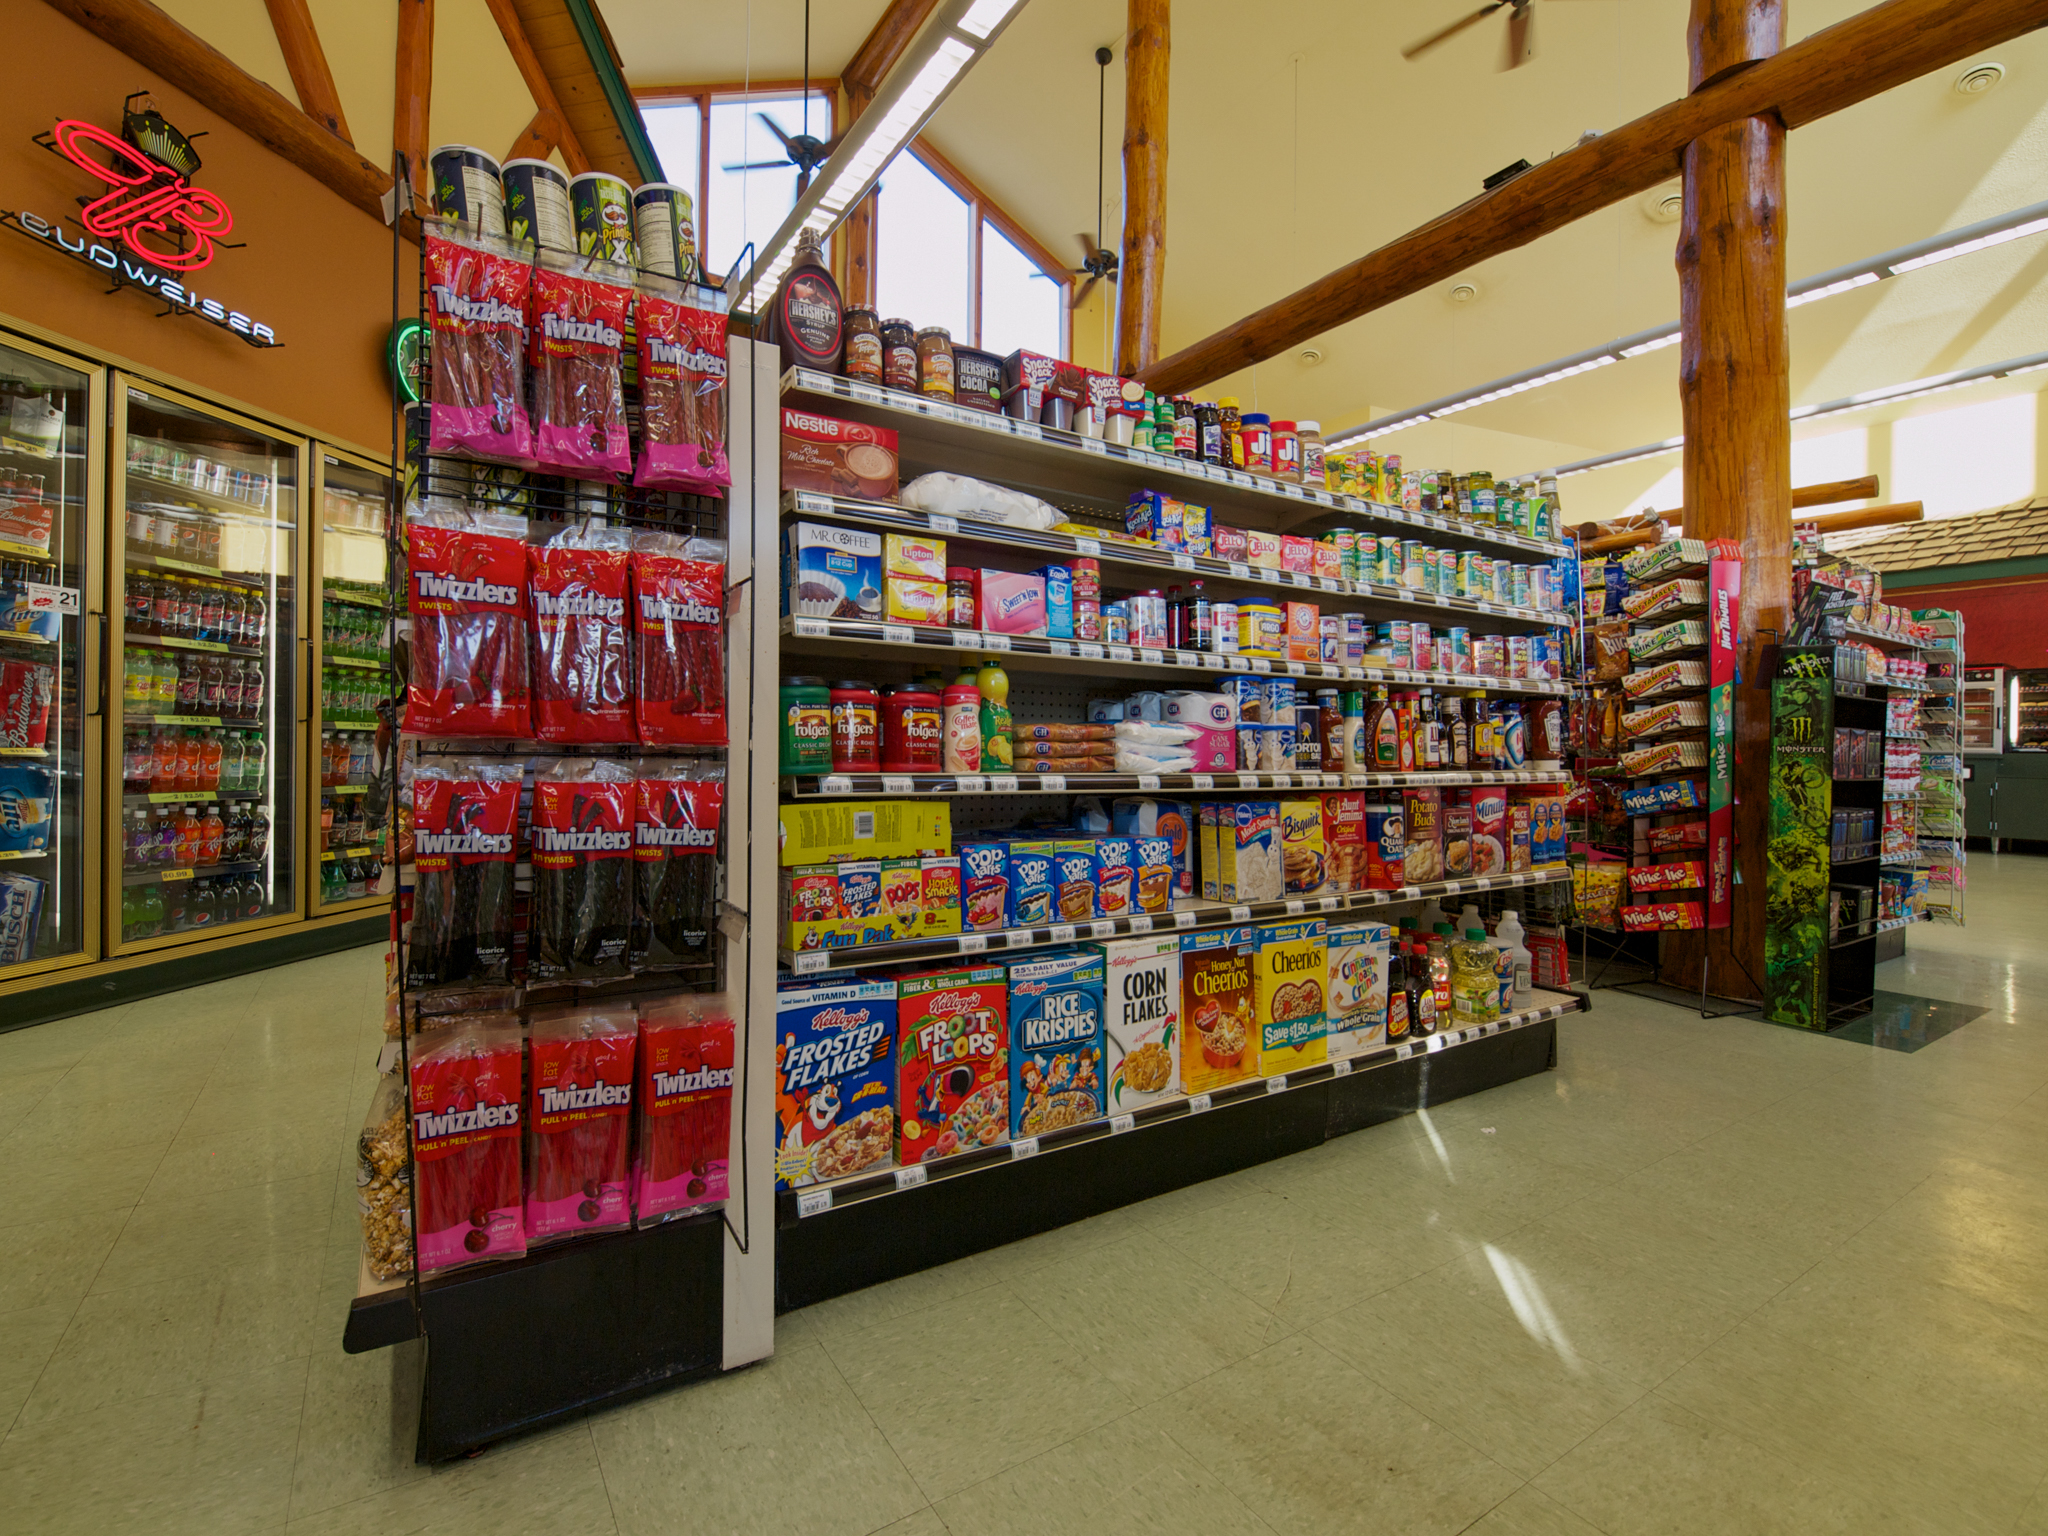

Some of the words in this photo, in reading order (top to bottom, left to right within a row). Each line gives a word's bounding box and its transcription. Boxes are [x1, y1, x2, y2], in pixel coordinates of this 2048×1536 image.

[431, 284, 524, 329] Twizzlers
[791, 300, 838, 327] HERSHEY'S
[806, 319, 826, 329] SYRUP
[800, 326, 830, 340] GENUINE
[544, 340, 573, 353] TWISTS
[960, 358, 1000, 381] HERSHEY'S
[1022, 358, 1054, 373] Snack
[960, 376, 988, 393] COCOA
[1088, 376, 1120, 390] Snack
[0, 510, 50, 528] Budweiser
[811, 529, 831, 542] MR.
[832, 532, 871, 548] COFFEE
[904, 548, 933, 560] Lipton
[1629, 559, 1652, 576] MIKE
[1658, 544, 1675, 557] IKE
[415, 571, 518, 605] Twizzlers
[60, 592, 77, 605] 21
[418, 601, 452, 612] TWISTS
[533, 591, 625, 617] Twizzlers
[904, 592, 934, 604] Lipton
[639, 595, 720, 625] Twizzlers
[1718, 589, 1732, 630] TAMALES
[1261, 622, 1280, 632] ARGO
[1291, 635, 1307, 643] Baking
[1634, 639, 1657, 654] MIKE
[1663, 625, 1680, 638] IKE
[1721, 630, 1733, 650] HOT
[1783, 656, 1832, 675] MONSTER
[8, 671, 34, 749] Budweiser
[954, 715, 976, 725] Coffee
[960, 721, 977, 731] mate
[795, 722, 829, 740] Folgers
[837, 720, 873, 740] Folgers
[908, 721, 938, 740] Folgers
[1776, 745, 1826, 754] MONSTER
[1716, 741, 1728, 780] Mike
[1341, 798, 1360, 812] Aunt
[1410, 800, 1438, 813] Potato
[1626, 795, 1657, 809] Mike
[1658, 787, 1680, 802] Ike
[1336, 809, 1363, 823] Jemima
[1414, 812, 1436, 826] Buds
[1476, 800, 1504, 822] Minute
[1514, 810, 1527, 819] RICE
[636, 822, 716, 846] Twizzlers
[1162, 823, 1182, 837] Gold
[1283, 812, 1321, 840] Bisquick
[1336, 824, 1356, 834] Original
[414, 830, 512, 854] Twizzlers
[542, 828, 631, 850] Twizzlers
[544, 855, 574, 864] TWISTS
[635, 849, 662, 858] TWISTS
[416, 858, 447, 867] TWISTS
[1103, 868, 1129, 878] Strawberry
[1631, 871, 1663, 888] Mike
[1664, 867, 1686, 882] Ike
[843, 881, 877, 897] FROSTED
[928, 877, 955, 888] HONEY
[974, 878, 993, 886] Cherry
[800, 887, 831, 902] FROOT
[844, 890, 873, 904] FLAKES
[886, 881, 920, 908] POPS
[925, 885, 958, 898] SMACKS
[804, 896, 833, 908] LOOPS
[1, 888, 28, 962] BUSCH
[924, 913, 936, 925] 8
[1623, 911, 1655, 926] Mike
[1658, 909, 1679, 922] Ike
[601, 939, 627, 947] licorice
[822, 930, 857, 948] Fun
[863, 924, 894, 942] Pak
[1111, 956, 1138, 967] Kellogg's
[1211, 960, 1232, 973] Honey
[1234, 957, 1245, 968] Nut
[1272, 947, 1321, 974] Cheerios
[1342, 956, 1379, 980] Cinnamon
[937, 979, 953, 988] WHOLE
[955, 978, 969, 987] GRAIN
[1124, 967, 1166, 1001] CORN
[1194, 968, 1249, 997] Cheerios
[1355, 967, 1373, 984] Toast
[812, 992, 848, 1001] VITAMIN
[850, 990, 856, 998] D
[1015, 982, 1048, 996] Kellogg's
[1352, 974, 1379, 1001] Crunch
[929, 992, 981, 1014] Kellogg's
[1044, 993, 1079, 1020] RICE
[1124, 996, 1168, 1026] FLAKES
[812, 1008, 870, 1030] Kellogg's
[1336, 1014, 1362, 1030] Whole
[1362, 1011, 1381, 1023] Grain
[919, 1010, 992, 1051] FROOT
[1026, 1011, 1095, 1045] KRISPIES
[1264, 1027, 1289, 1044] Save
[655, 1046, 670, 1055] low
[785, 1022, 885, 1071] FROSTED
[931, 1032, 998, 1065] LOOPS
[543, 1060, 559, 1069] low
[655, 1054, 669, 1063] fat
[543, 1068, 558, 1077] fat
[786, 1046, 872, 1090] FLAKES
[416, 1083, 435, 1092] low
[653, 1064, 734, 1096] Twizzlers
[416, 1091, 434, 1101] fat
[539, 1080, 631, 1114] Twizzlers
[414, 1102, 519, 1140] Twizzlers
[541, 1115, 559, 1125] PULL
[569, 1111, 588, 1121] PEEL
[708, 1173, 729, 1181] cherry
[491, 1221, 517, 1232] cherry
